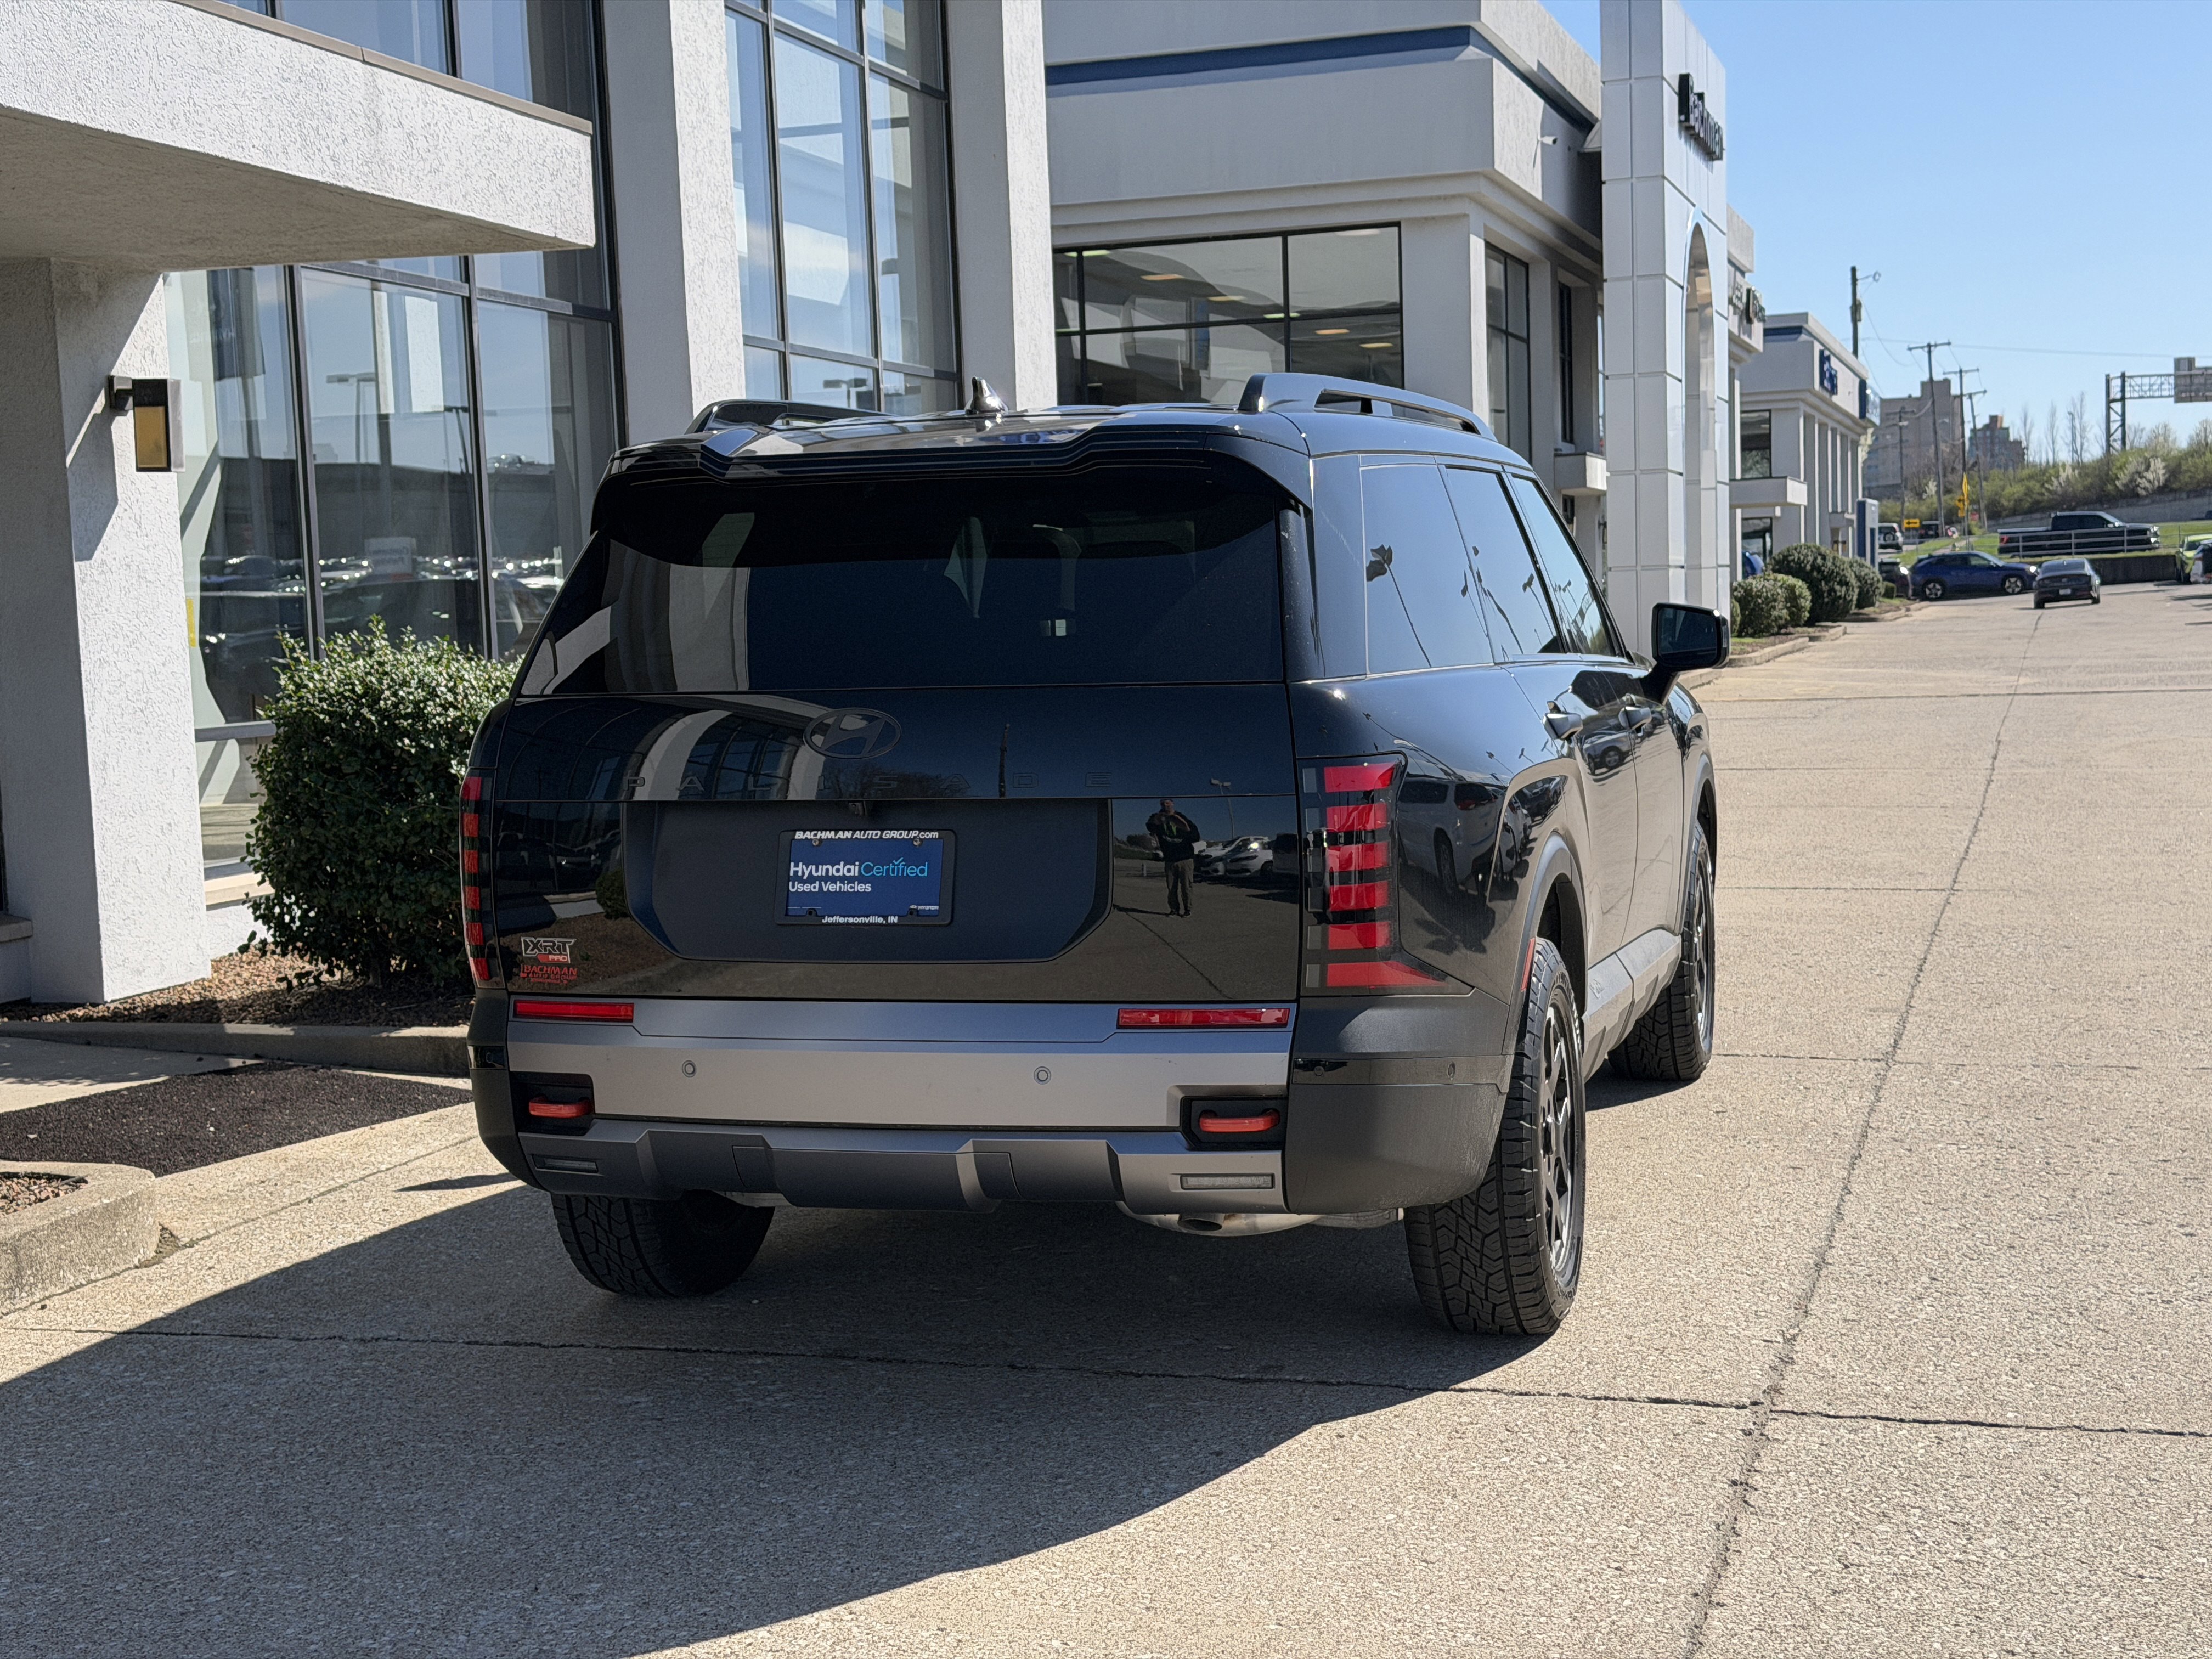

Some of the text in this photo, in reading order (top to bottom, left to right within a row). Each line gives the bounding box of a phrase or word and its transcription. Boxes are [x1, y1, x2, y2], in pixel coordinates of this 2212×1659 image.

[623, 772, 1112, 791] PALISADE
[794, 831, 852, 839] BACHMAN
[853, 831, 881, 839] AUTO
[789, 858, 928, 879] Hyundai Certified
[789, 881, 872, 892] Used Vehicles
[822, 916, 886, 924] Jeffersonville,
[522, 937, 575, 955] XRT
[524, 965, 577, 975] BACHMAN
